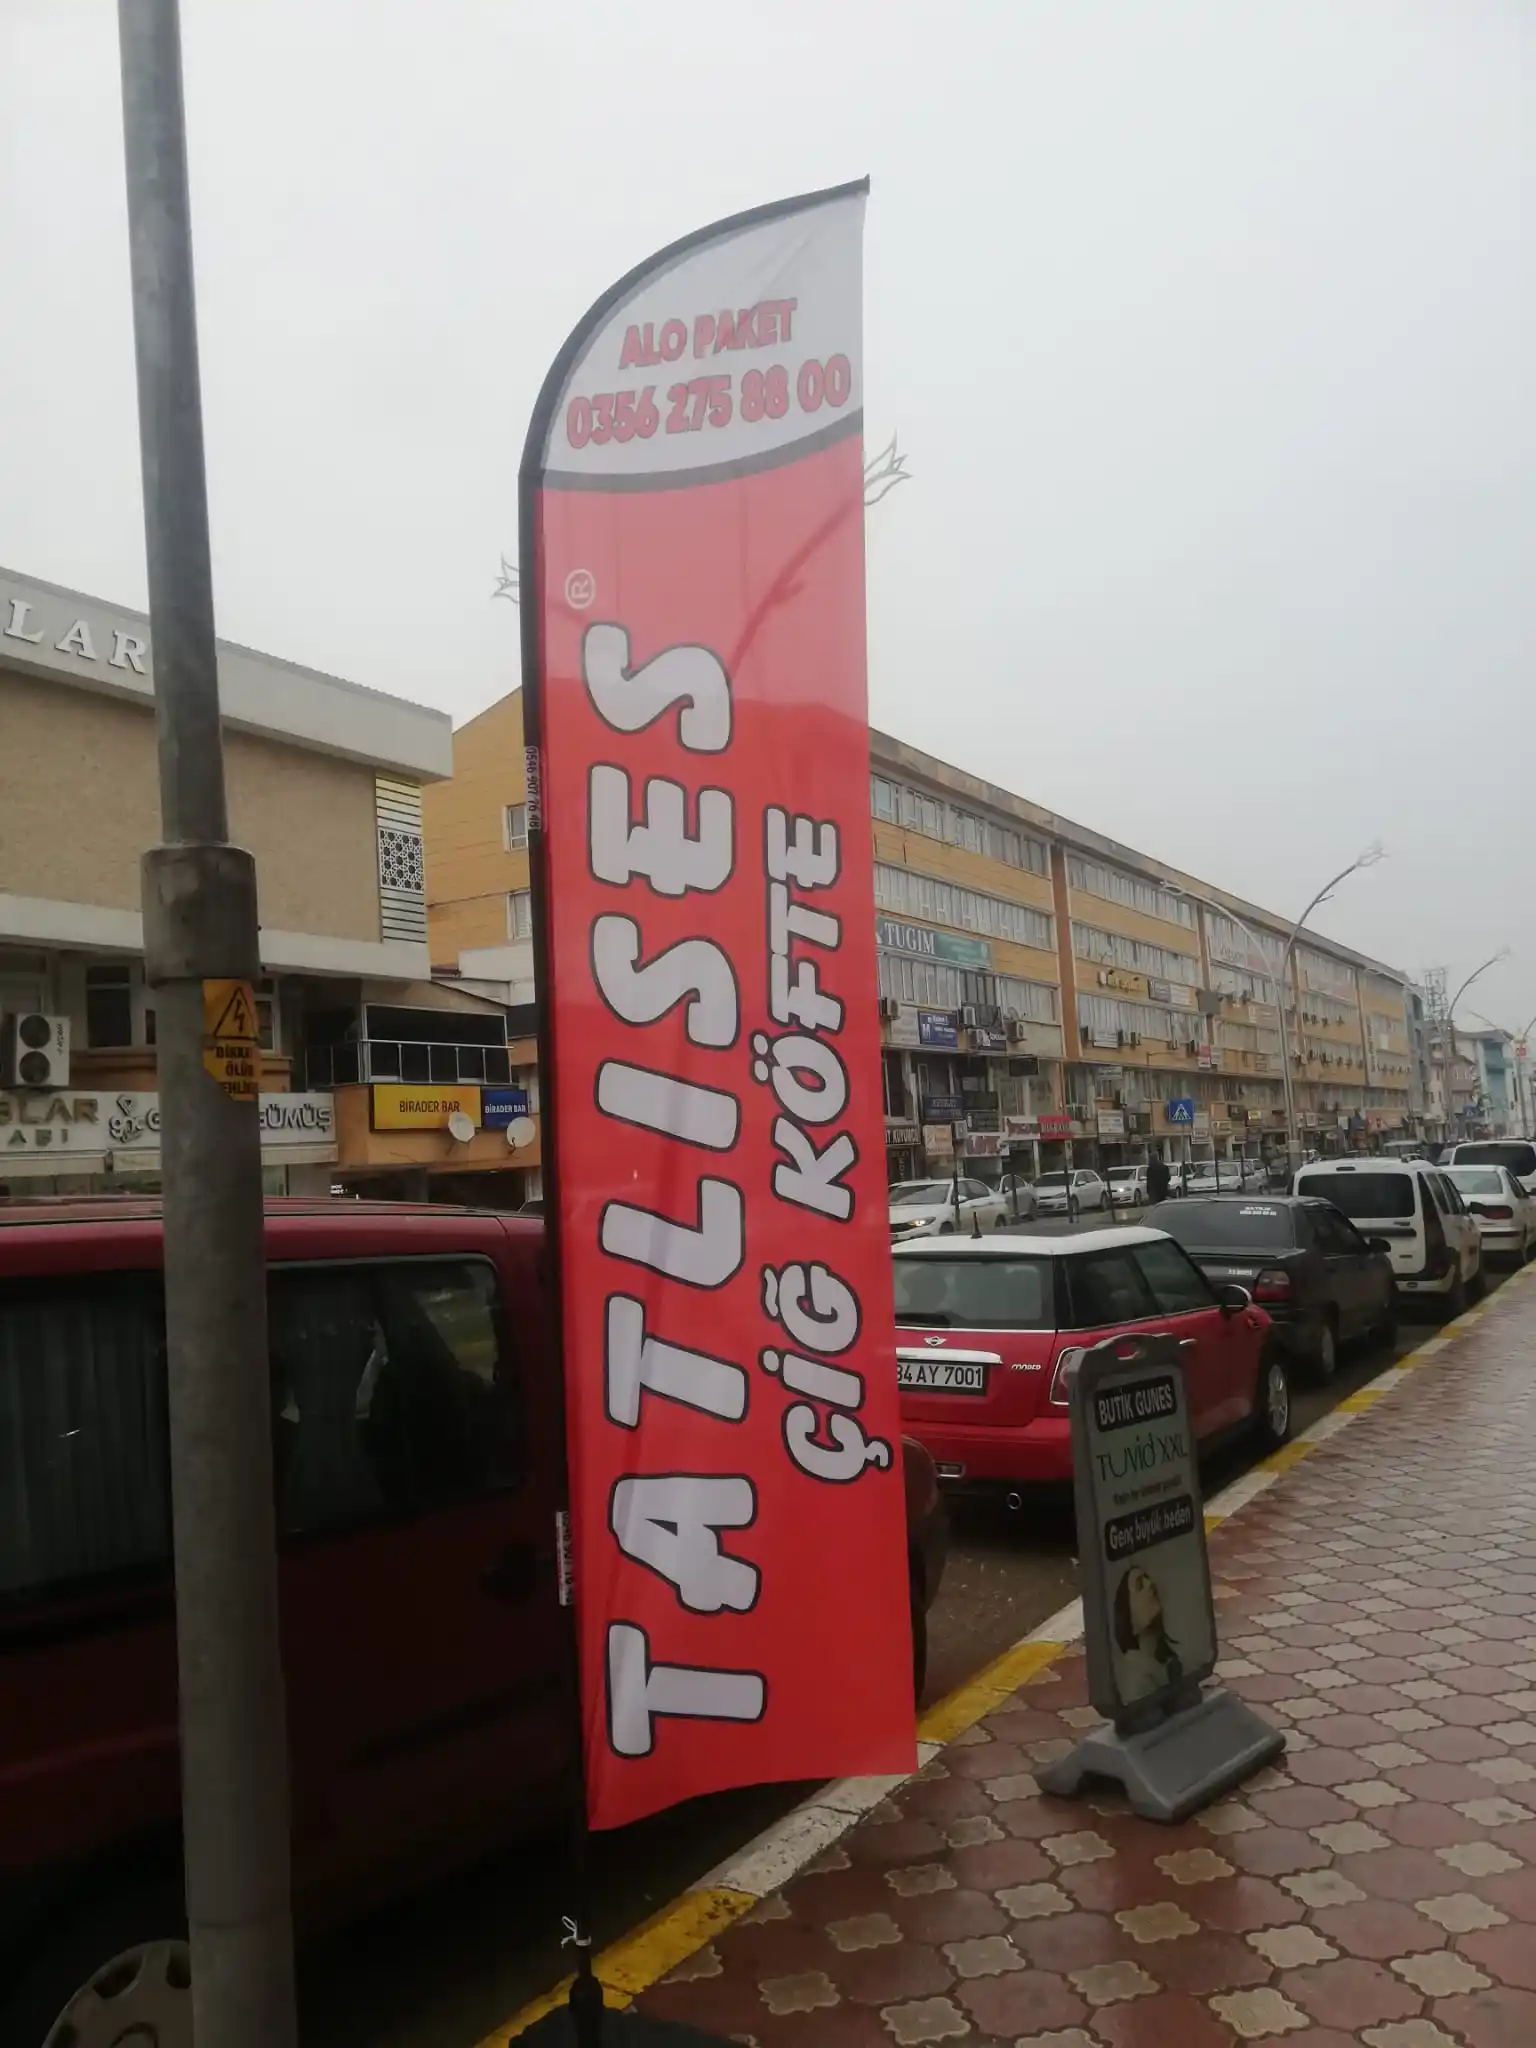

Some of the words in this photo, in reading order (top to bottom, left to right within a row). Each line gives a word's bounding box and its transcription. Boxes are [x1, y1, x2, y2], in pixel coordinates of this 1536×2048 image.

[618, 318, 688, 369] ALO
[693, 297, 797, 359] PAKET
[566, 386, 659, 449] 0356
[666, 374, 733, 434] 275
[740, 364, 790, 423] 88
[797, 353, 851, 413] 00
[747, 804, 858, 1222] KÖFTE
[400, 1098, 440, 1113] BİRADER
[441, 1101, 460, 1113] BAR
[484, 1103, 513, 1114] BİRADER
[513, 1103, 526, 1113] BAR
[583, 621, 768, 1758] TATLISES
[757, 1260, 894, 1485] ÇİĞ
[916, 1364, 939, 1384] AY
[944, 1366, 982, 1387] 7001
[1157, 1432, 1189, 1463] XXL
